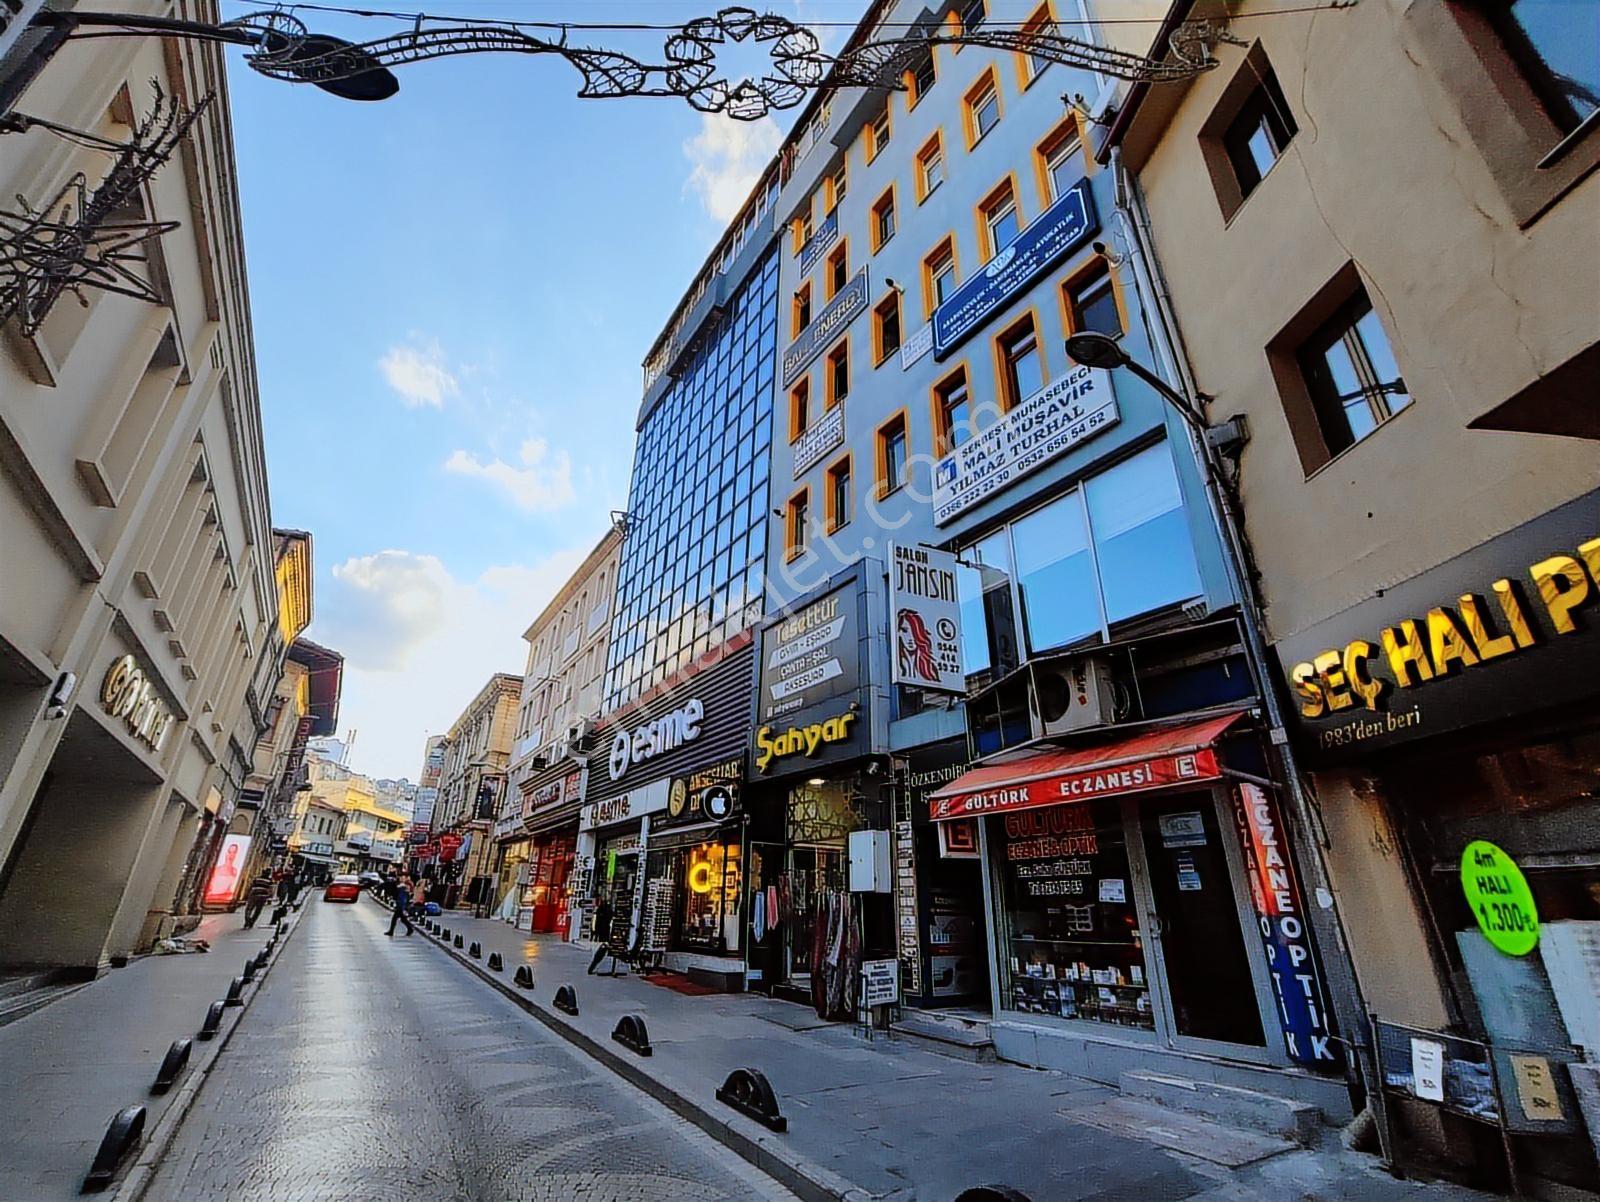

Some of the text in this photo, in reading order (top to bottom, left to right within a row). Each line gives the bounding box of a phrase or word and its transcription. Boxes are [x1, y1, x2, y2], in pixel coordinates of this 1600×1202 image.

[950, 405, 1085, 496] YILMAZ TURHAL
[961, 422, 1008, 459] SERBEST
[963, 379, 1095, 472] MALİ MÜŞAVİR
[997, 470, 1010, 484] 30
[1017, 449, 1045, 471] 0532
[1046, 435, 1069, 453] 656
[1071, 423, 1087, 440] 54
[1089, 411, 1106, 428] 52
[896, 546, 929, 564] SALON
[775, 597, 840, 645] Tesettür
[1292, 639, 1383, 718] SEÇ
[1380, 577, 1536, 688] HALI
[632, 697, 704, 763] esme
[755, 711, 855, 774] Şahyar
[1320, 705, 1421, 750] 1983'den beri
[965, 787, 1030, 811] GÜLTÜRK
[1060, 763, 1153, 797] ECZANESİ
[1180, 757, 1197, 776] E
[1476, 875, 1513, 895] HALI
